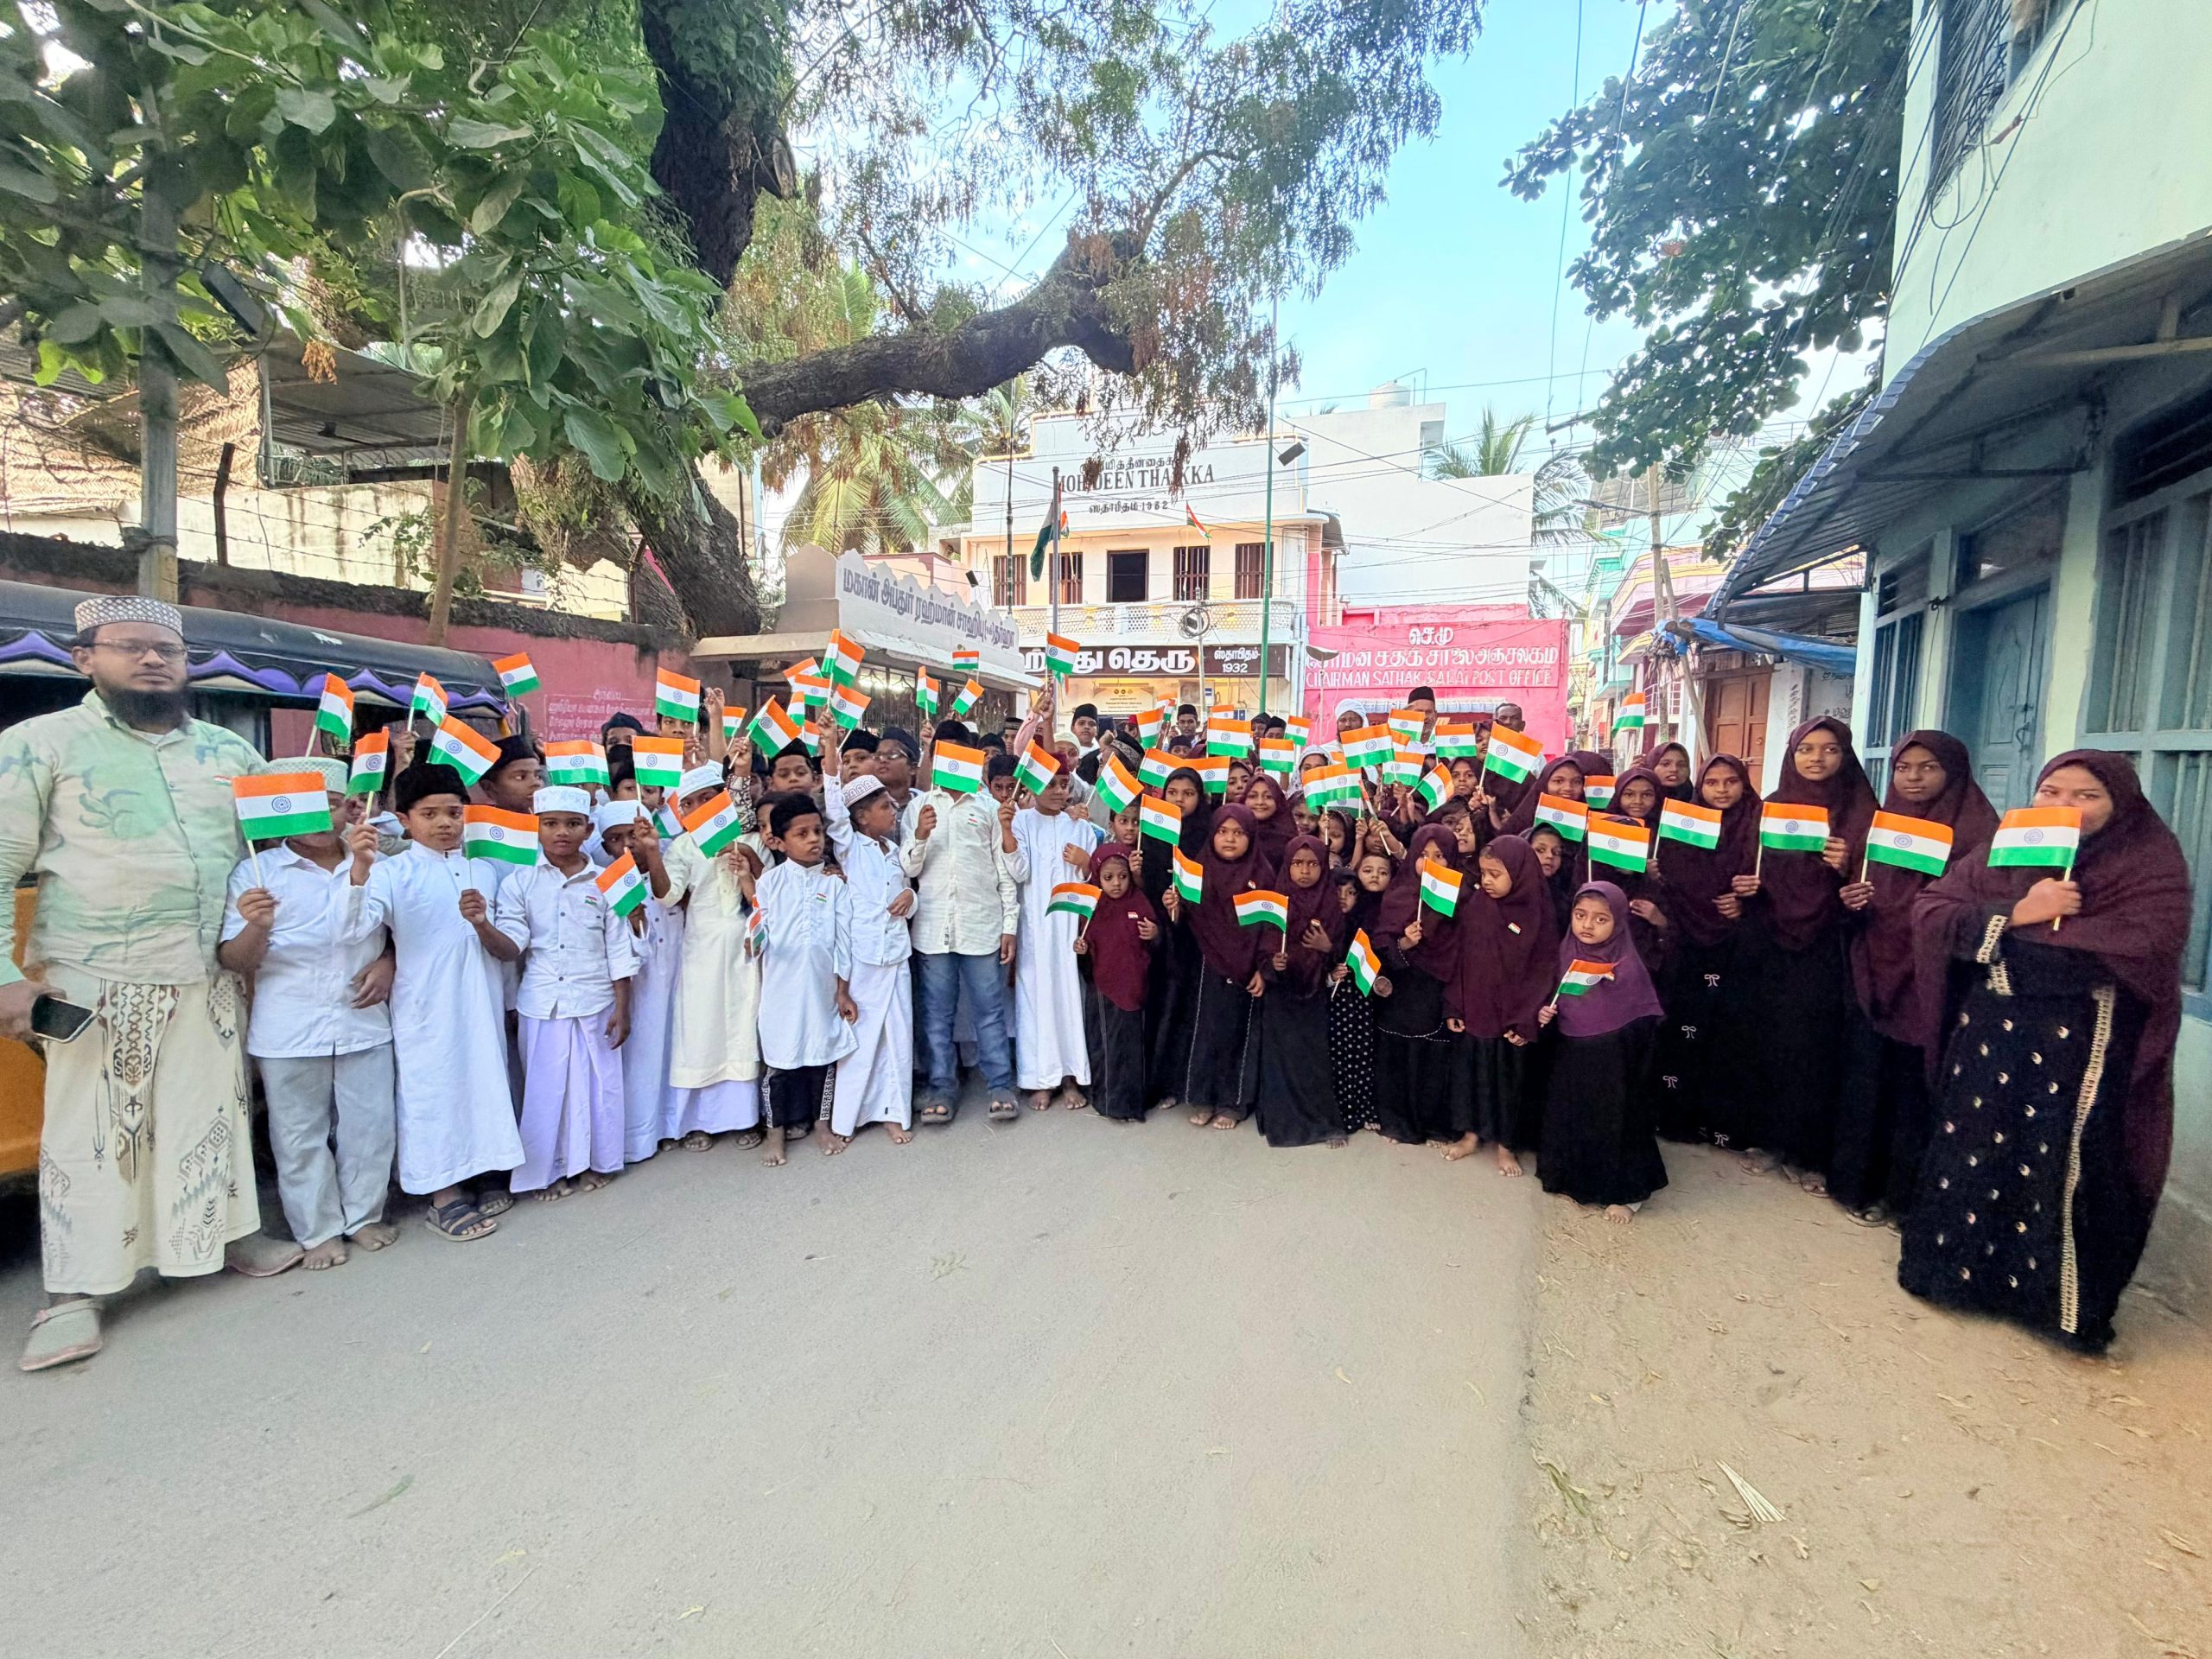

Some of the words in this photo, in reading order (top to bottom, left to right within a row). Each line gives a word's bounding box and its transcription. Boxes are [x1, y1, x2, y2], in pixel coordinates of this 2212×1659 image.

[1057, 471, 1135, 492] OHDEEN
[1137, 464, 1215, 487] THAKKA
[843, 567, 880, 602] மகான்
[915, 593, 956, 628] ரஹ்மான்
[1109, 647, 1196, 673] தெரு
[1222, 663, 1248, 673] 1932
[1306, 670, 1370, 688] CHAIRMAN
[1373, 670, 1421, 685] SATHAK
[1472, 669, 1506, 684] POST
[1509, 668, 1552, 686] OFFICE
